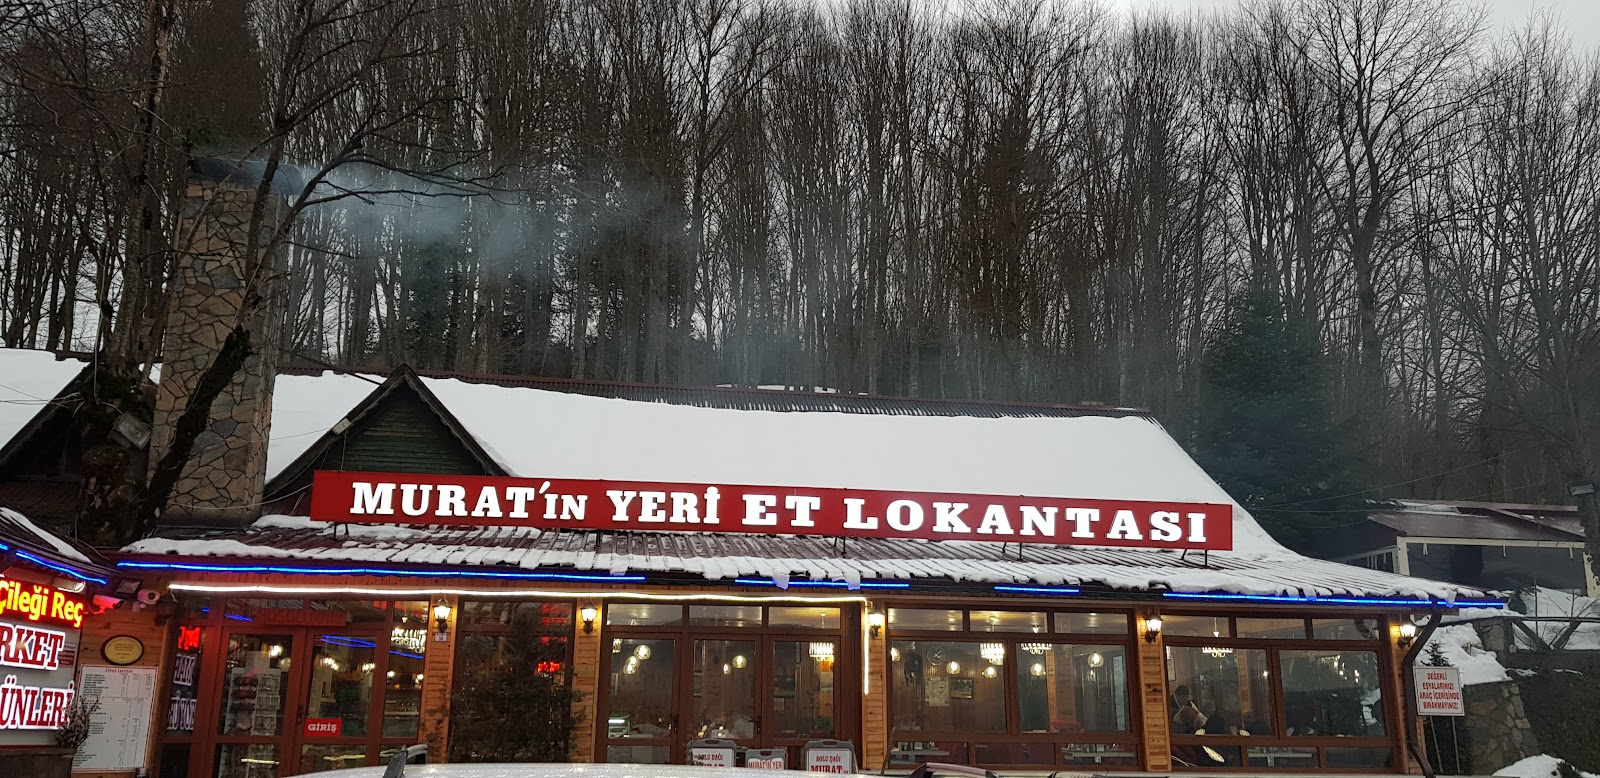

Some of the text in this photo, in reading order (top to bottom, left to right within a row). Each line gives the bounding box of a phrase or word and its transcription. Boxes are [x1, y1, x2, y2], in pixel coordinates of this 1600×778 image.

[606, 486, 721, 524] YERİ
[741, 494, 821, 527] ET
[843, 498, 1207, 543] LOKANTASI
[51, 592, 84, 628] Reç
[1427, 671, 1447, 680] DEĞERLİ
[1420, 691, 1432, 701] ARAÇ
[307, 722, 337, 734] GİRİŞ
[816, 755, 828, 763] BOLU
[810, 765, 843, 774] MURAT
